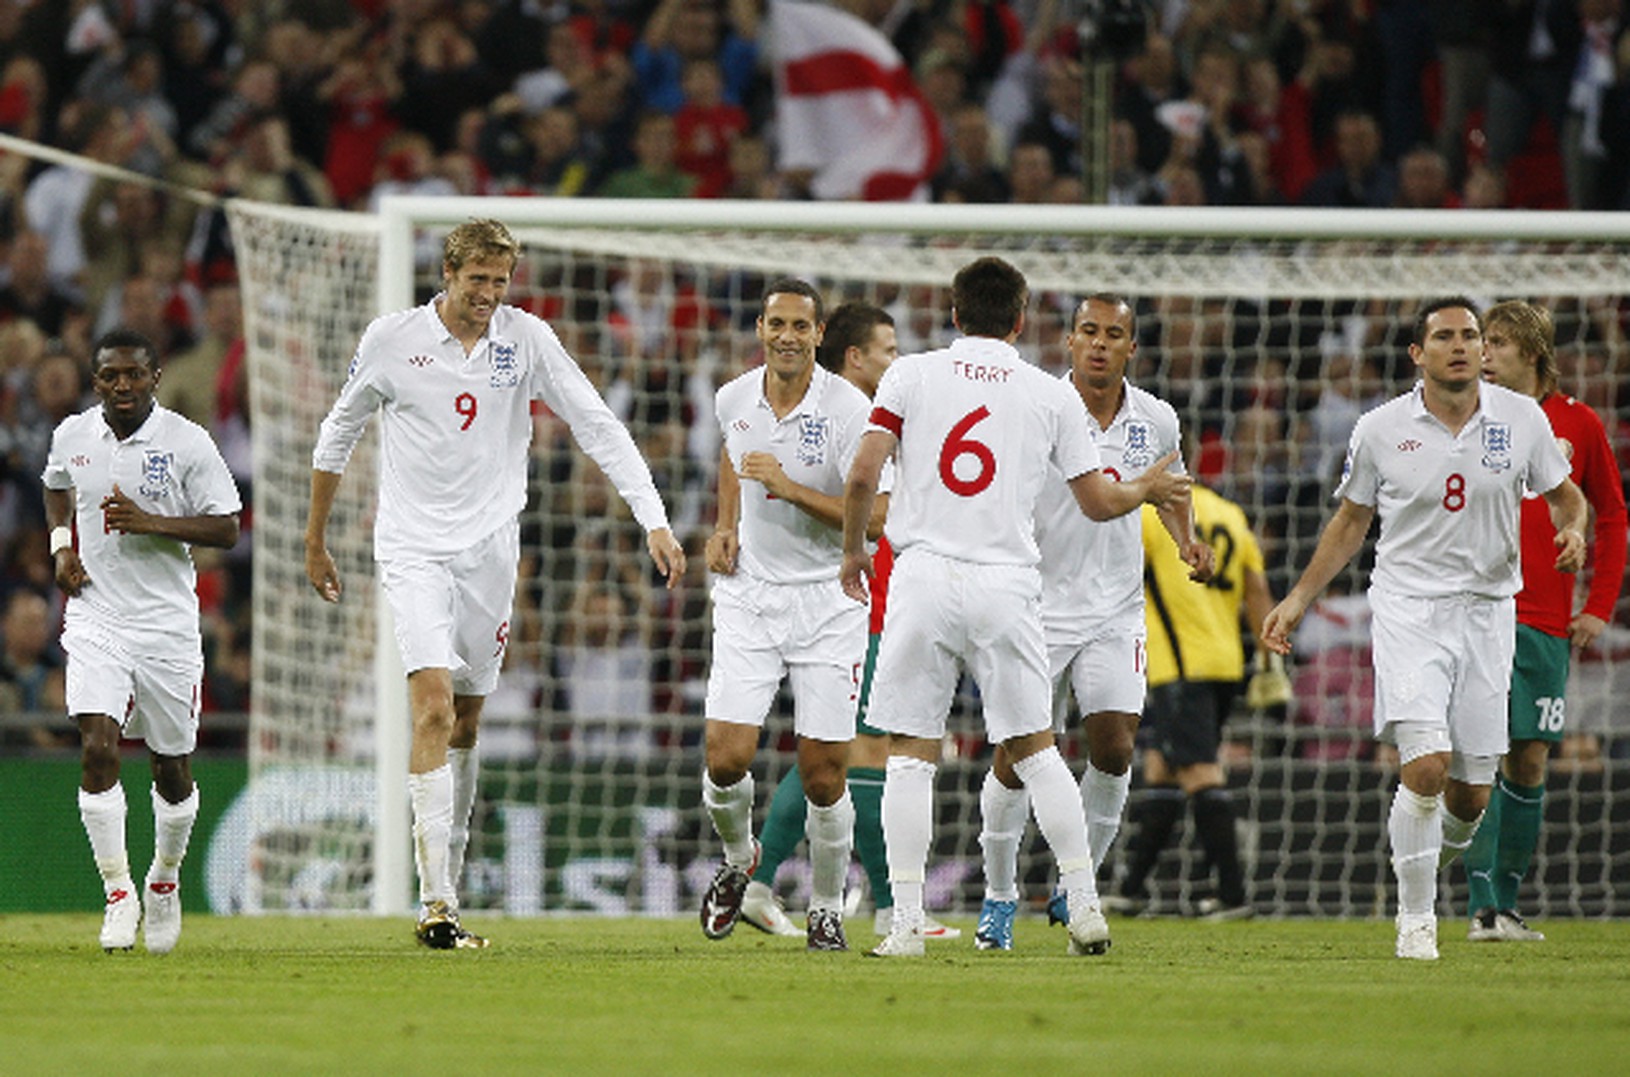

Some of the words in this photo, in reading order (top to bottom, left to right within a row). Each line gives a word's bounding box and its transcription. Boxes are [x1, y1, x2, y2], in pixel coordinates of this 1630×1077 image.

[953, 360, 1014, 382] TERRY
[455, 392, 477, 431] 9
[939, 405, 996, 497] 6
[1443, 473, 1466, 512] 8
